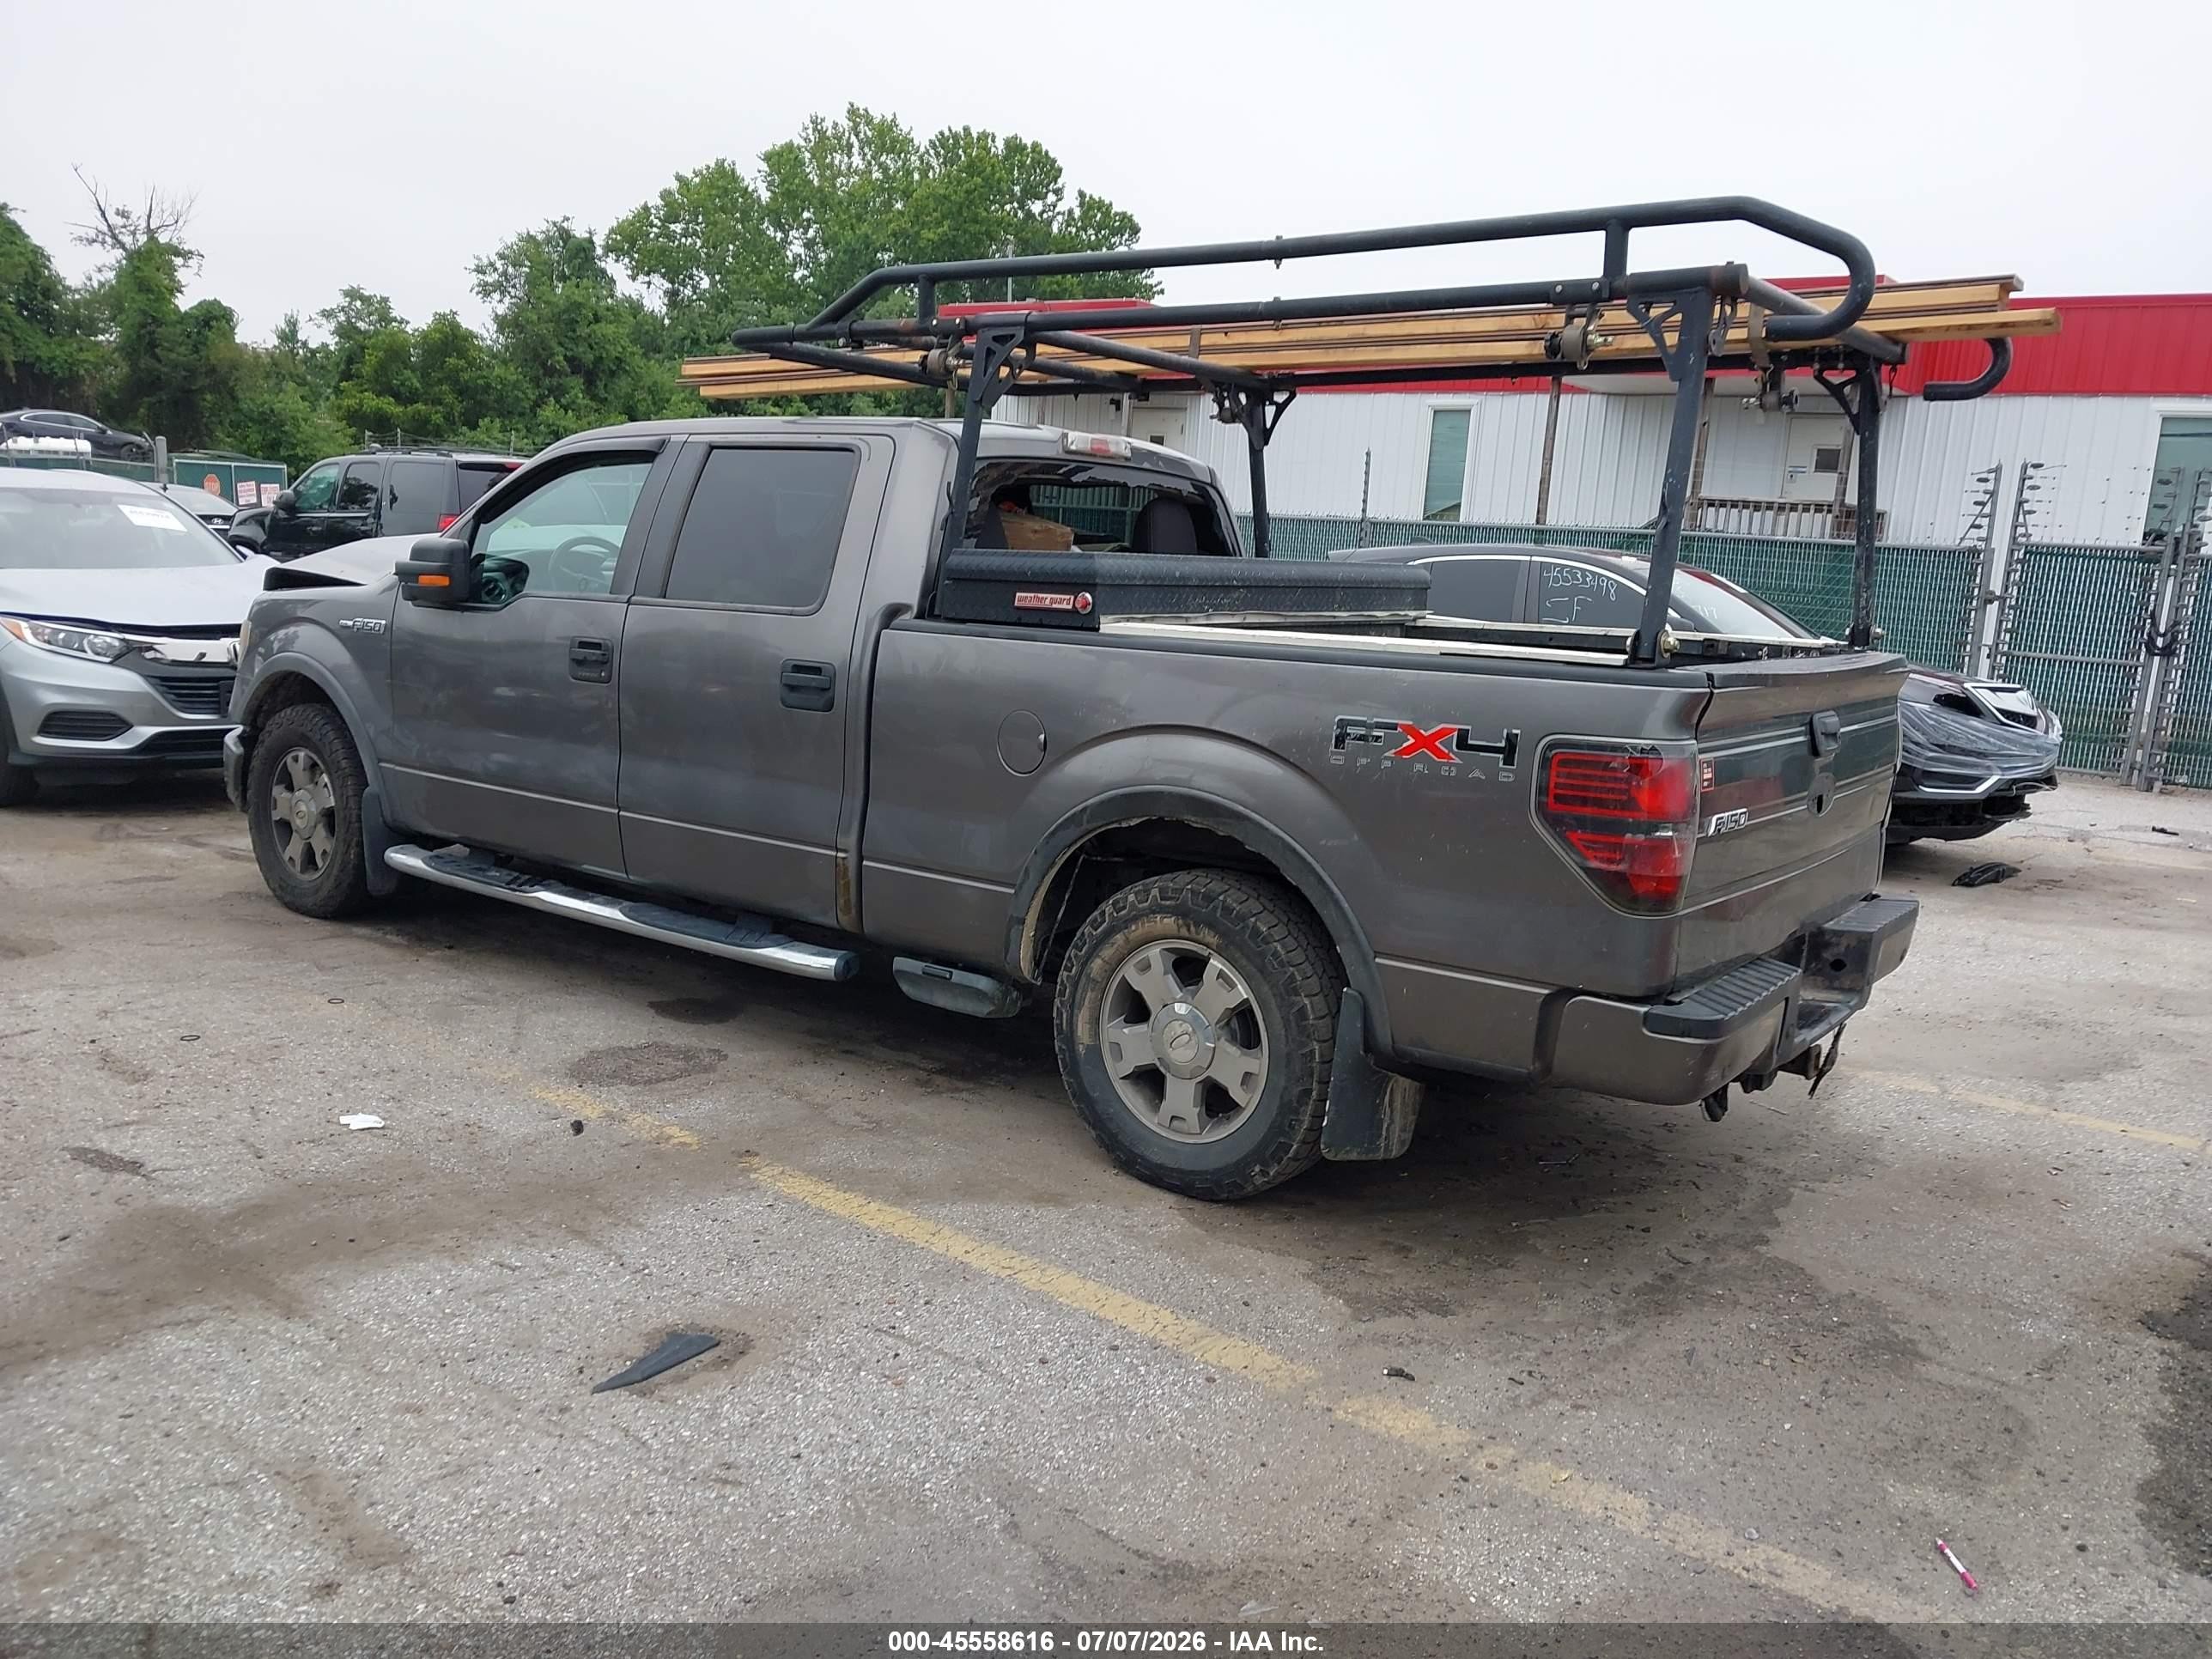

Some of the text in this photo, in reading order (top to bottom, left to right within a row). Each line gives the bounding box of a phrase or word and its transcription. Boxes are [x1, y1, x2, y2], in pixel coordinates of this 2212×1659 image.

[1017, 593, 1073, 606] weather guard
[1543, 564, 1618, 602] 45533498
[1331, 715, 1521, 769] FX4
